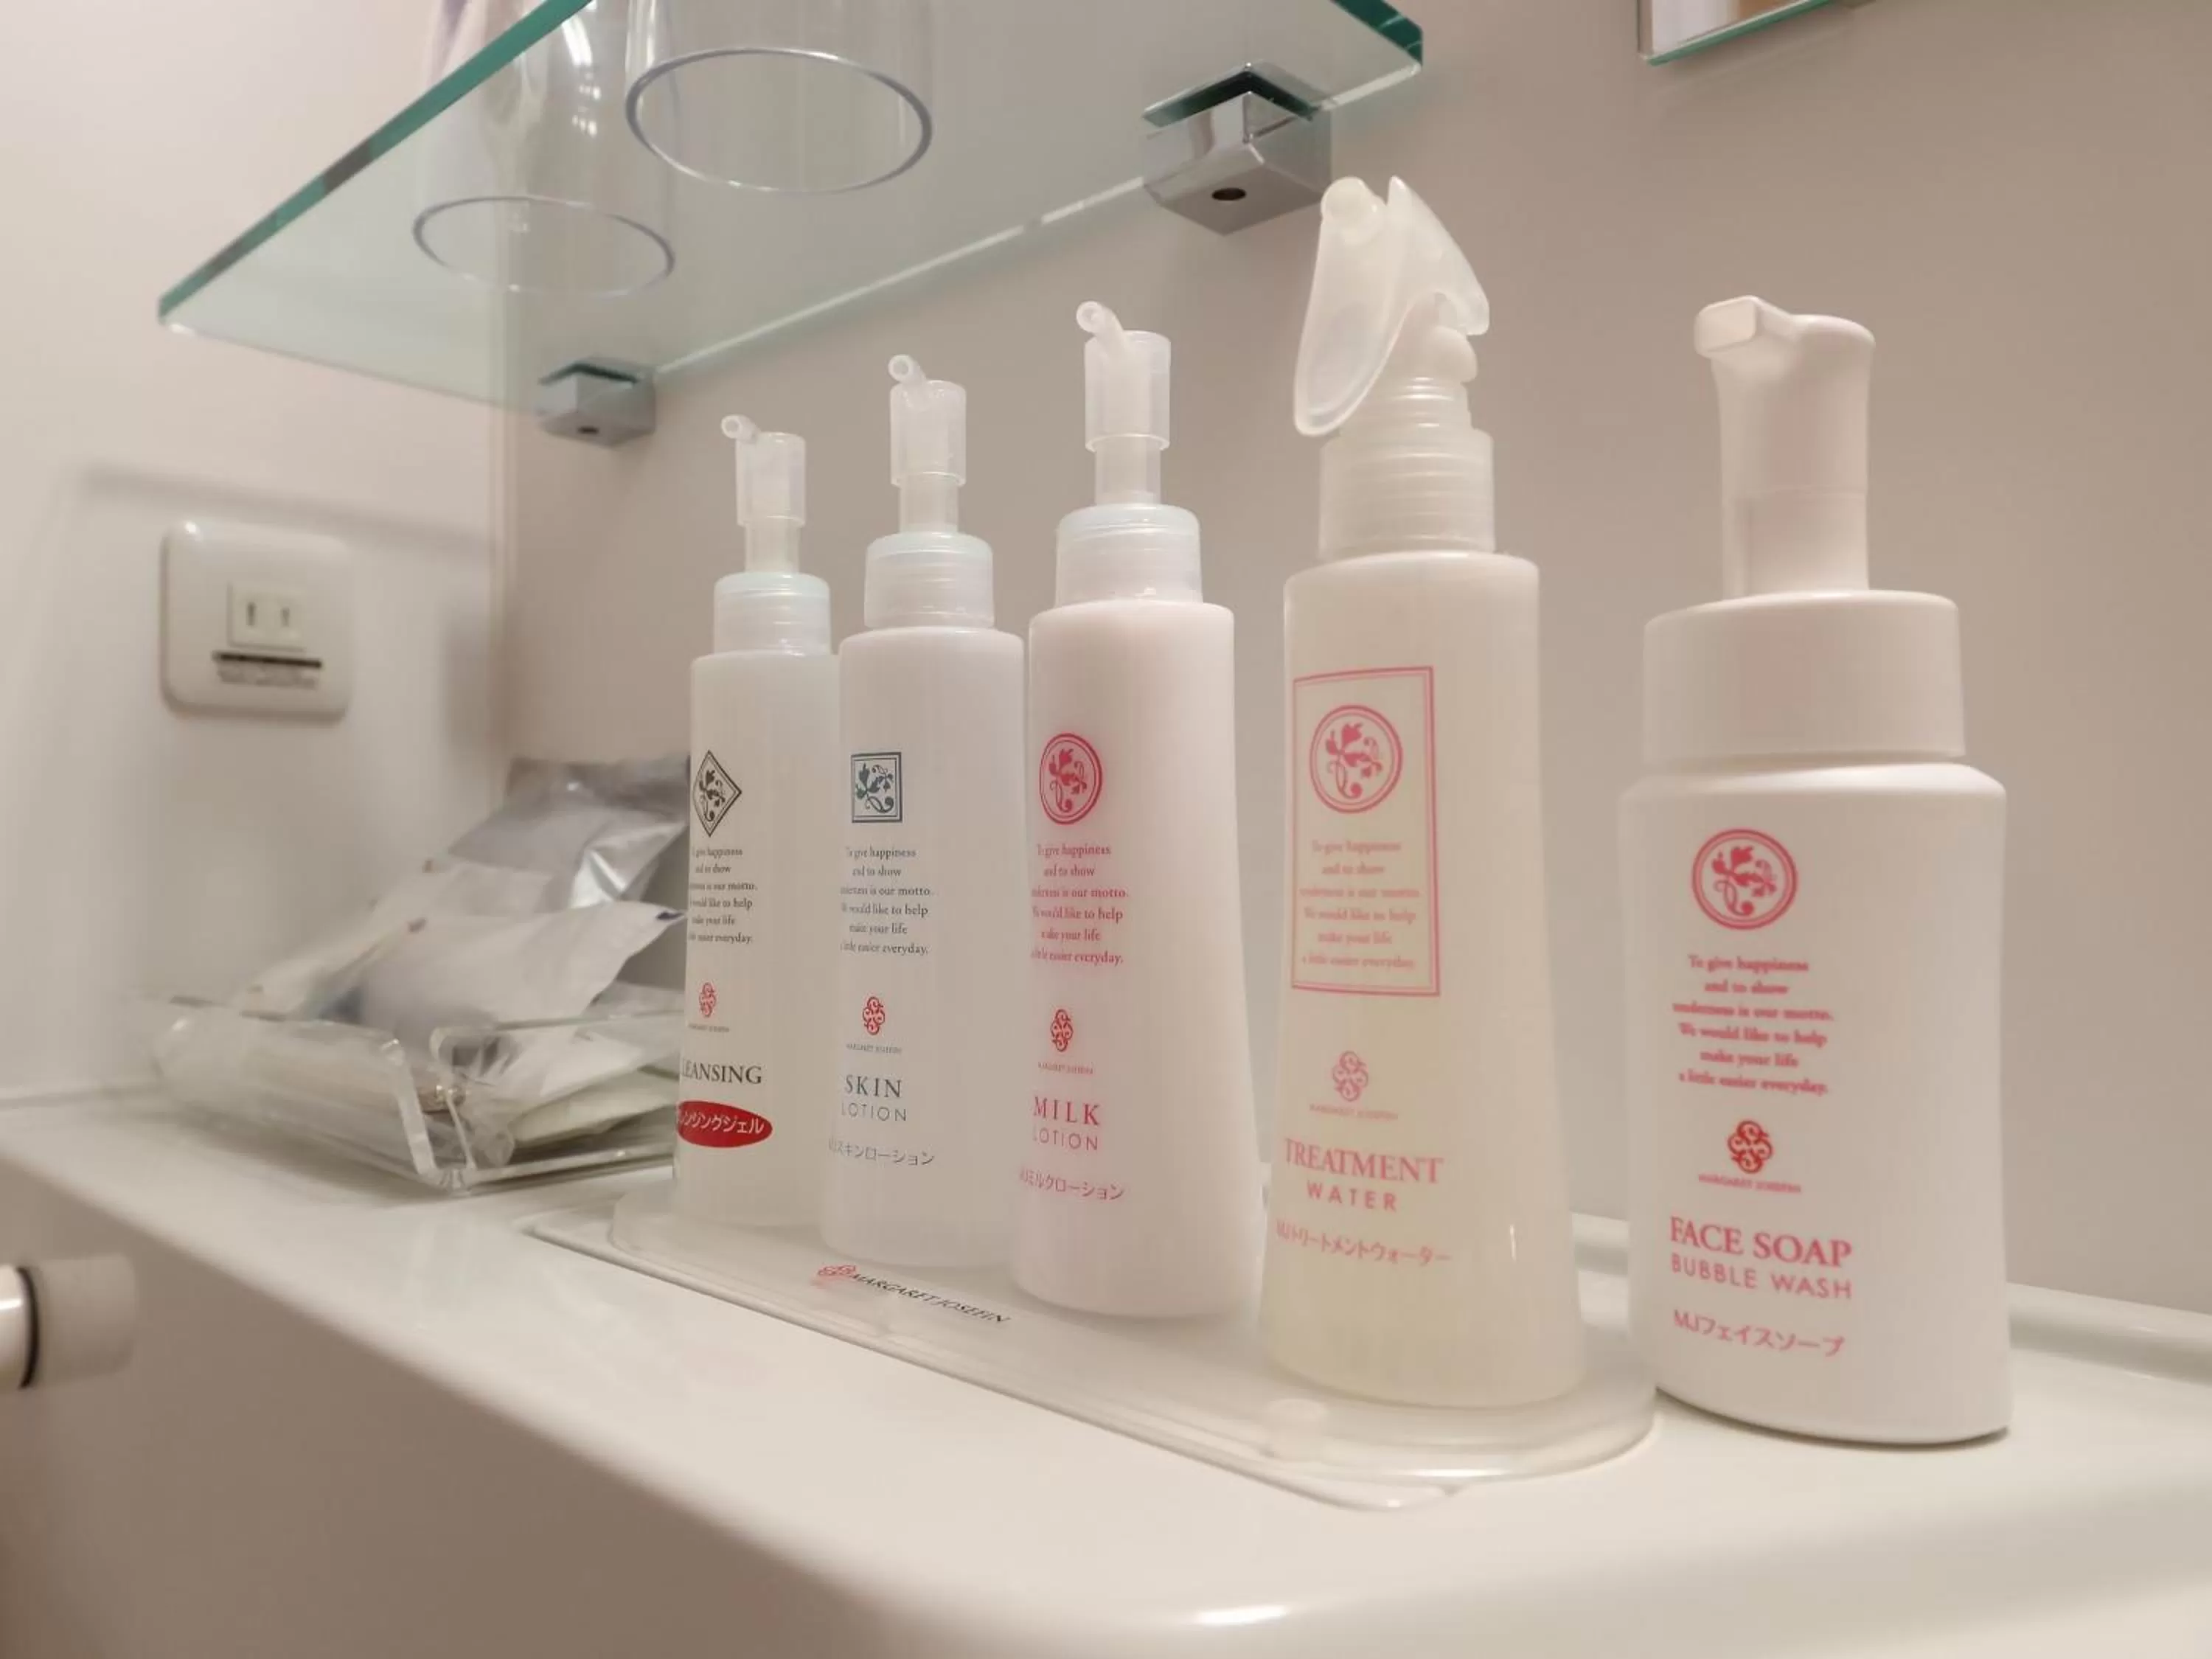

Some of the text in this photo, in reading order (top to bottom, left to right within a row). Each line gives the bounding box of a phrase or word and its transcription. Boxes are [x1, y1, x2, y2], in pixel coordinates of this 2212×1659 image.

[869, 844, 917, 860] happiness
[1061, 844, 1111, 859] happiness
[1070, 864, 1095, 877] show
[1071, 888, 1087, 897] our
[734, 897, 753, 911] help
[891, 905, 902, 914] to
[905, 902, 928, 918] help
[1084, 908, 1095, 919] to
[1097, 906, 1123, 925] help
[891, 922, 908, 934] life
[1083, 928, 1102, 941] life
[1708, 957, 1732, 973] give
[1736, 956, 1809, 974] happiness
[1704, 978, 1789, 994] and to show
[1700, 1026, 1739, 1040] would
[1744, 1026, 1769, 1042] like
[1775, 1032, 1790, 1043] to
[1794, 1029, 1828, 1048] help
[1700, 1049, 1799, 1067] make your life
[681, 1058, 762, 1085] LEANSING
[845, 1074, 901, 1098] SKIN
[841, 1102, 906, 1121] LOTION
[1034, 1096, 1099, 1125] MILK
[1033, 1125, 1099, 1151] LOTION
[1284, 1138, 1446, 1184] TREATMENT
[1307, 1180, 1398, 1213] WATER
[1670, 1216, 1853, 1268] FACE SOAP
[1672, 1252, 1853, 1300] BUBBLE WASH
[1673, 1309, 1846, 1358] MJフェイスソープ
